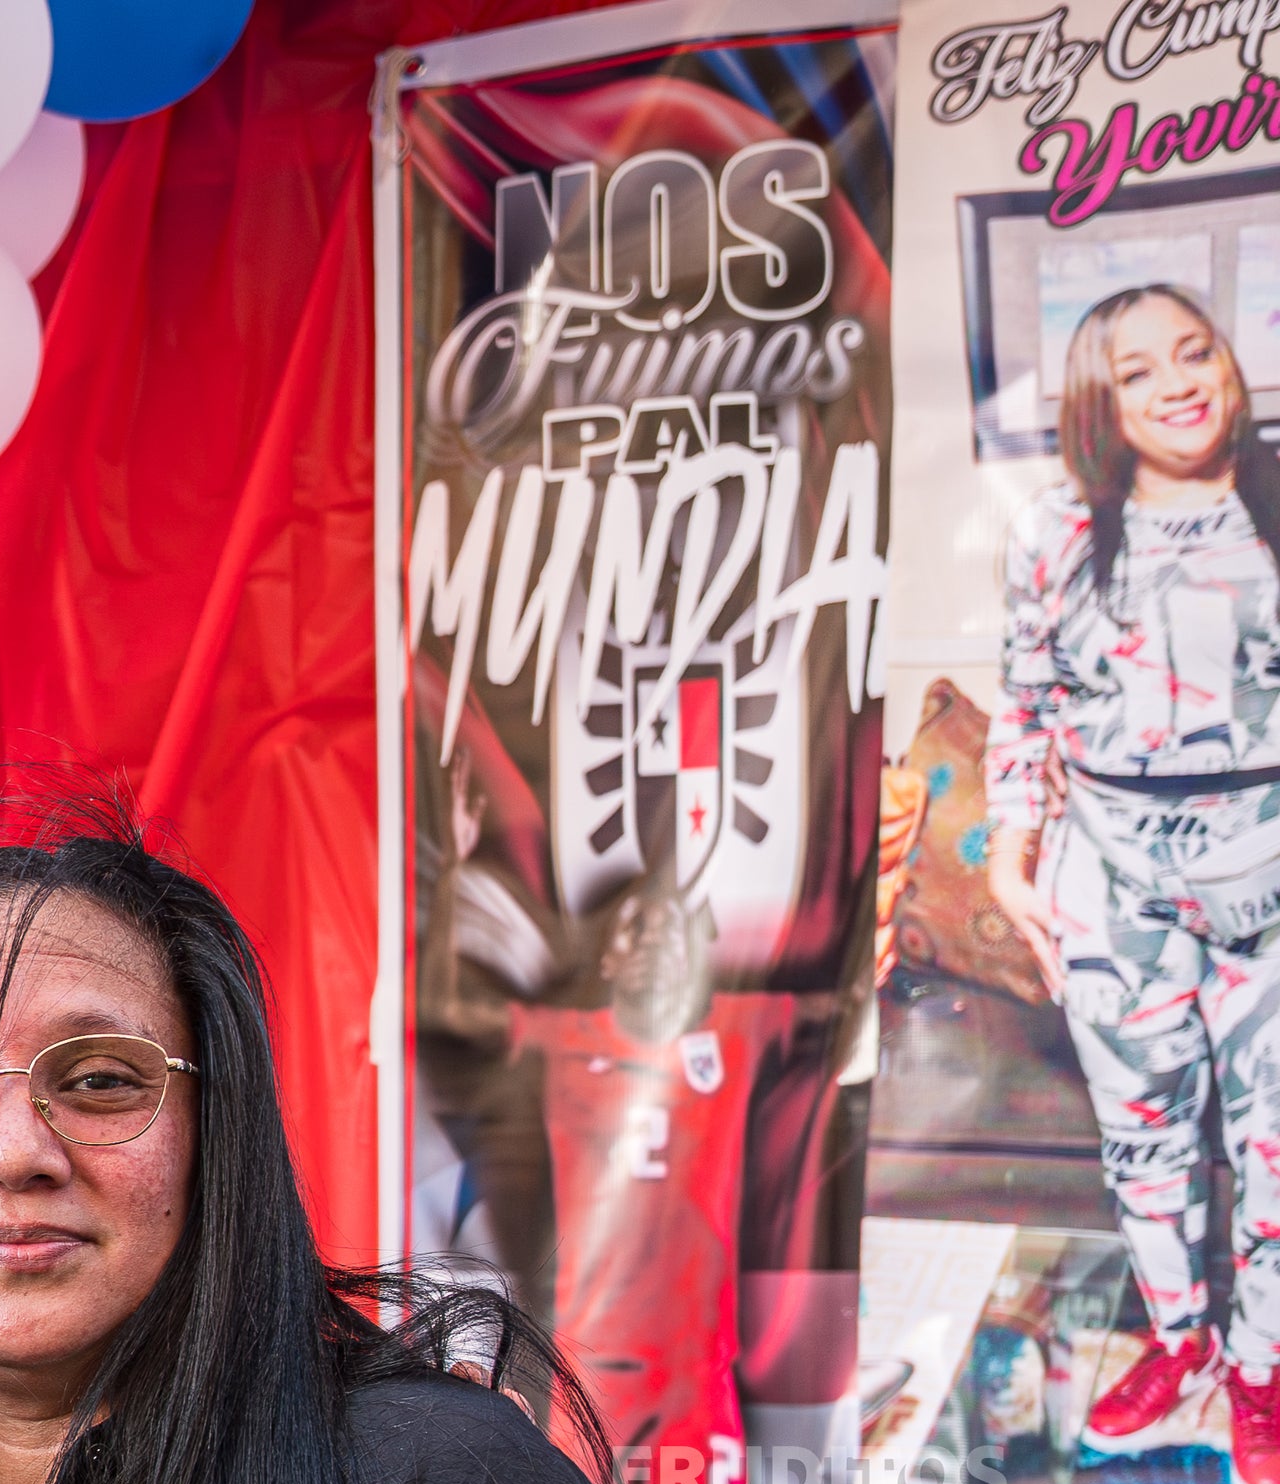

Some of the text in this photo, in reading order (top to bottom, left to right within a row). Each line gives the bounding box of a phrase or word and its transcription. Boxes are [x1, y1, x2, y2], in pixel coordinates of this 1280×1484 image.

[931, 6, 1101, 126] Feliz
[495, 139, 834, 331] NOS
[427, 276, 864, 455] Fuimos
[542, 391, 778, 482] PAL
[402, 441, 888, 768] MUNDIA
